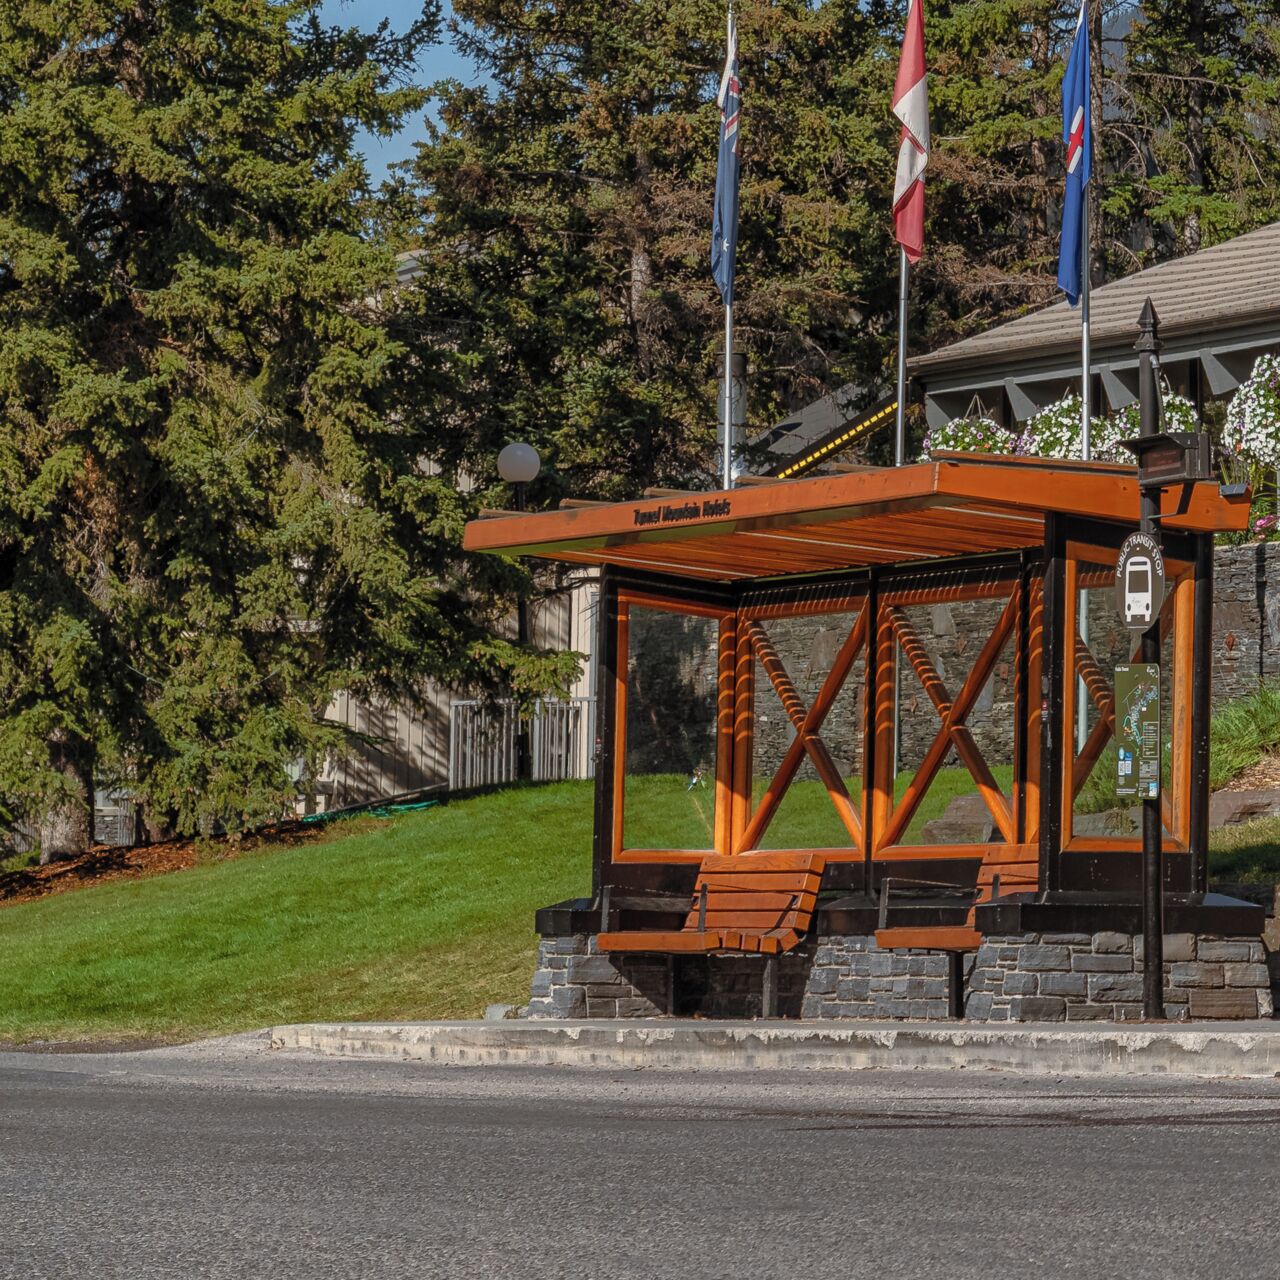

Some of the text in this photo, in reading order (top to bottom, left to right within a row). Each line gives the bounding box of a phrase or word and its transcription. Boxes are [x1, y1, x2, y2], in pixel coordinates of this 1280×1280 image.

[1116, 534, 1163, 578] PUBLIC TRANSIT STOP
